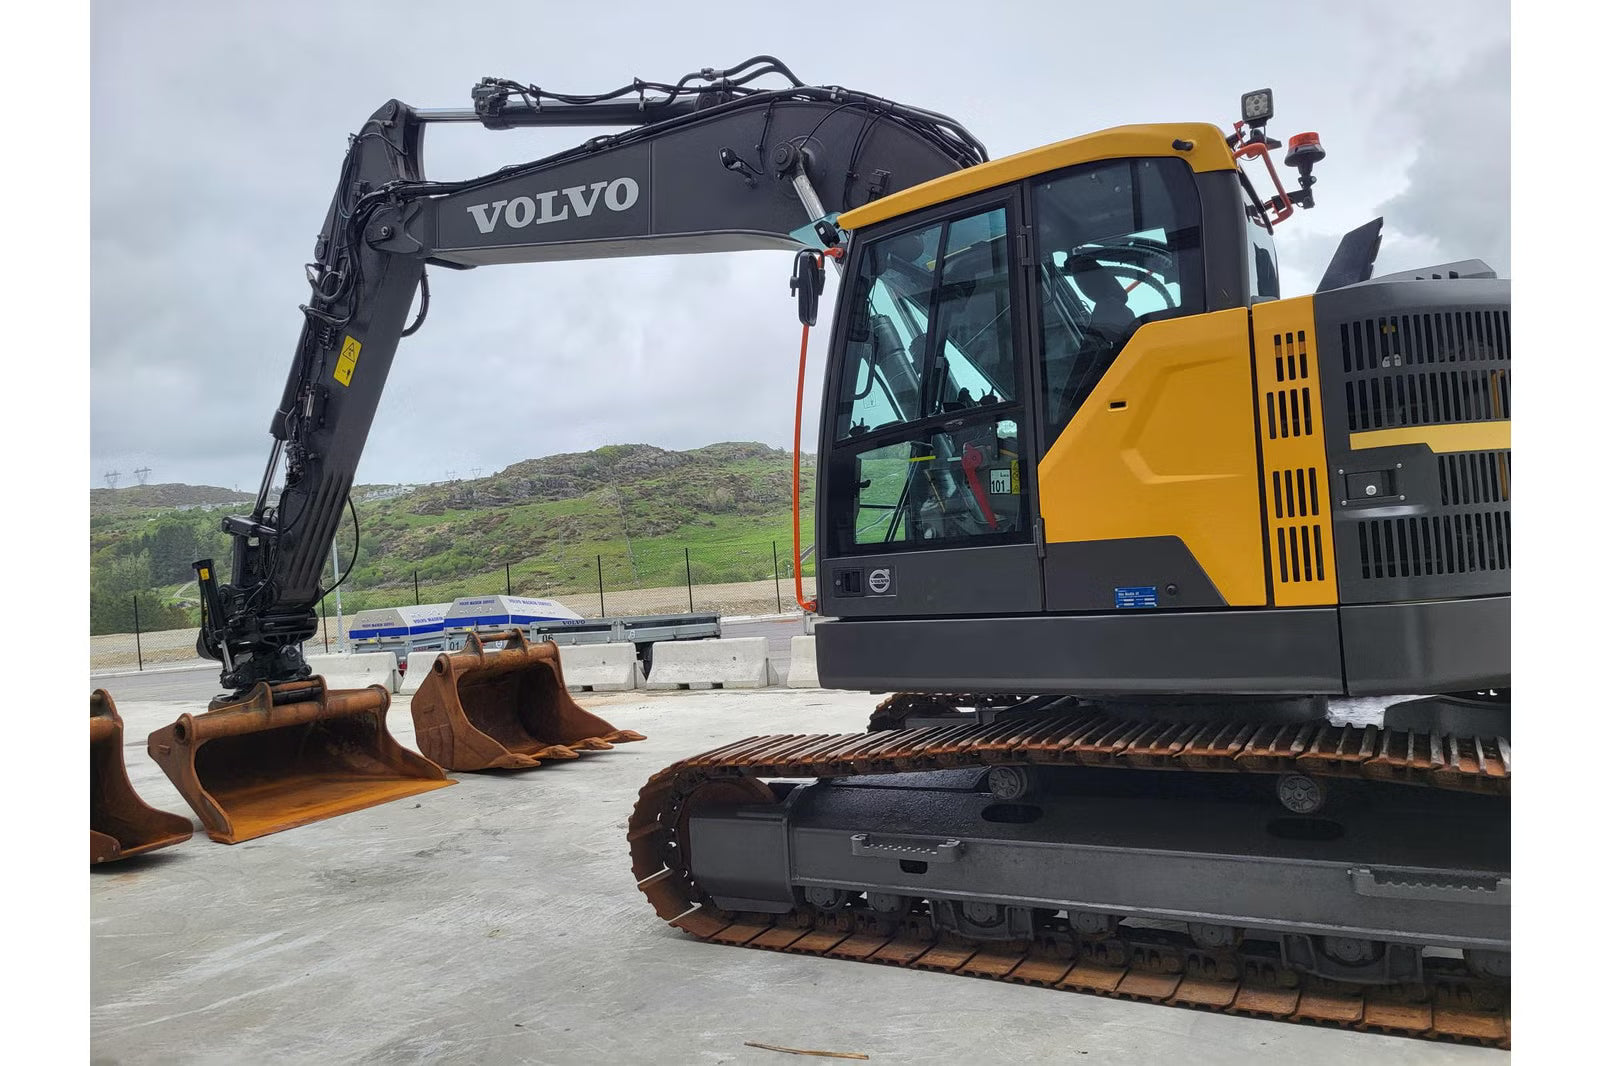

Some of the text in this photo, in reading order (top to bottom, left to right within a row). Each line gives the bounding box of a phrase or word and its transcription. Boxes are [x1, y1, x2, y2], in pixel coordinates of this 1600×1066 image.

[467, 177, 639, 234] VOLVO
[992, 480, 1005, 492] 101
[542, 633, 554, 641] 06
[449, 641, 459, 651] 01
